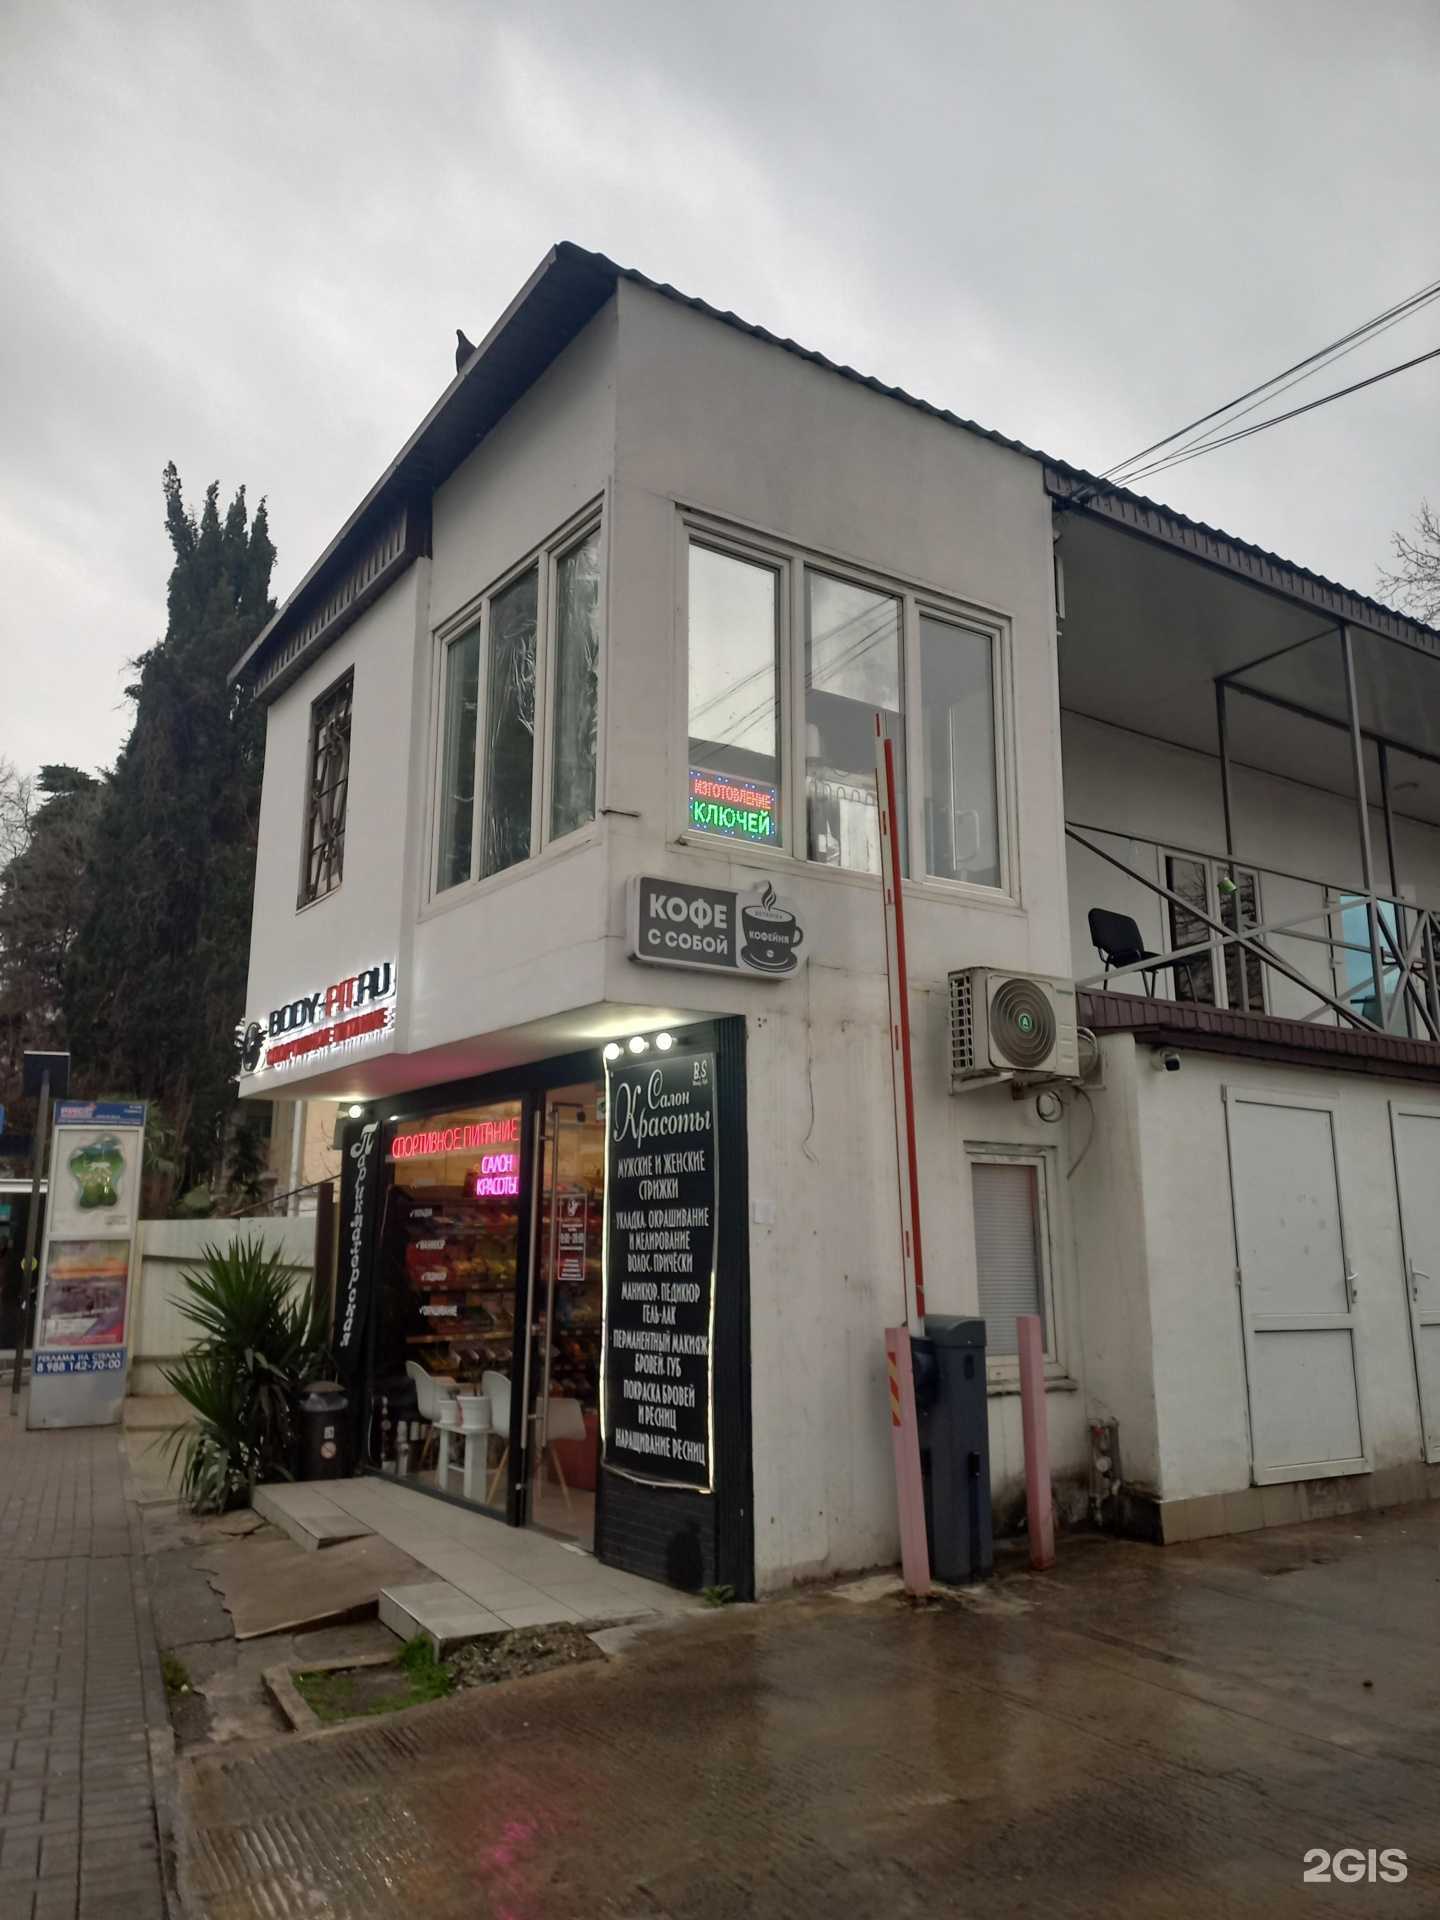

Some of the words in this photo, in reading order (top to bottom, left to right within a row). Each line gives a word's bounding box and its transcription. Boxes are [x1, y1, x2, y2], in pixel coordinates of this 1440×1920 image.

[695, 779, 772, 810] ИЗГОТОВЛЕНИЕ
[694, 801, 770, 835] КЛЮЧЕЙ
[650, 893, 728, 929] КОФЕ
[648, 928, 662, 946] С
[665, 930, 728, 955] СОБОЙ
[648, 1069, 689, 1109] Салон
[613, 1082, 711, 1148] Красоты
[392, 1127, 462, 1158] СПОРТИВНОЕ
[464, 1118, 519, 1150] ПИТАНИЕ
[481, 1154, 513, 1174] САЛОН
[617, 1155, 653, 1178] МУЖСКИЕ
[655, 1154, 662, 1175] И
[663, 1150, 705, 1174] ЖЕНСКИЕ
[476, 1176, 518, 1196] КРАСОТЫ
[639, 1178, 679, 1200] СТРИЖКИ
[648, 1207, 709, 1228] ОКРАШИВАНИЕ
[636, 1230, 690, 1250] МЕЛИРОВАНИЕ
[661, 1282, 700, 1303] ПЕДИКЮР
[643, 1304, 676, 1325] ГЕЛЬ-ЛАК
[613, 1329, 671, 1352] ПЕРМАНЕНТНЫЙ
[671, 1333, 708, 1355] МАКИЯЖ
[667, 1356, 682, 1378] ГУБ
[624, 1379, 661, 1403] ПОКРАСКА
[662, 1384, 695, 1408] БРОВЕЙ
[638, 1404, 644, 1424] И
[645, 1405, 677, 1432] РЕСНИЦ
[615, 1427, 671, 1458] НАРАЩИВАНИЕ
[672, 1438, 706, 1467] РЕСНИЦ
